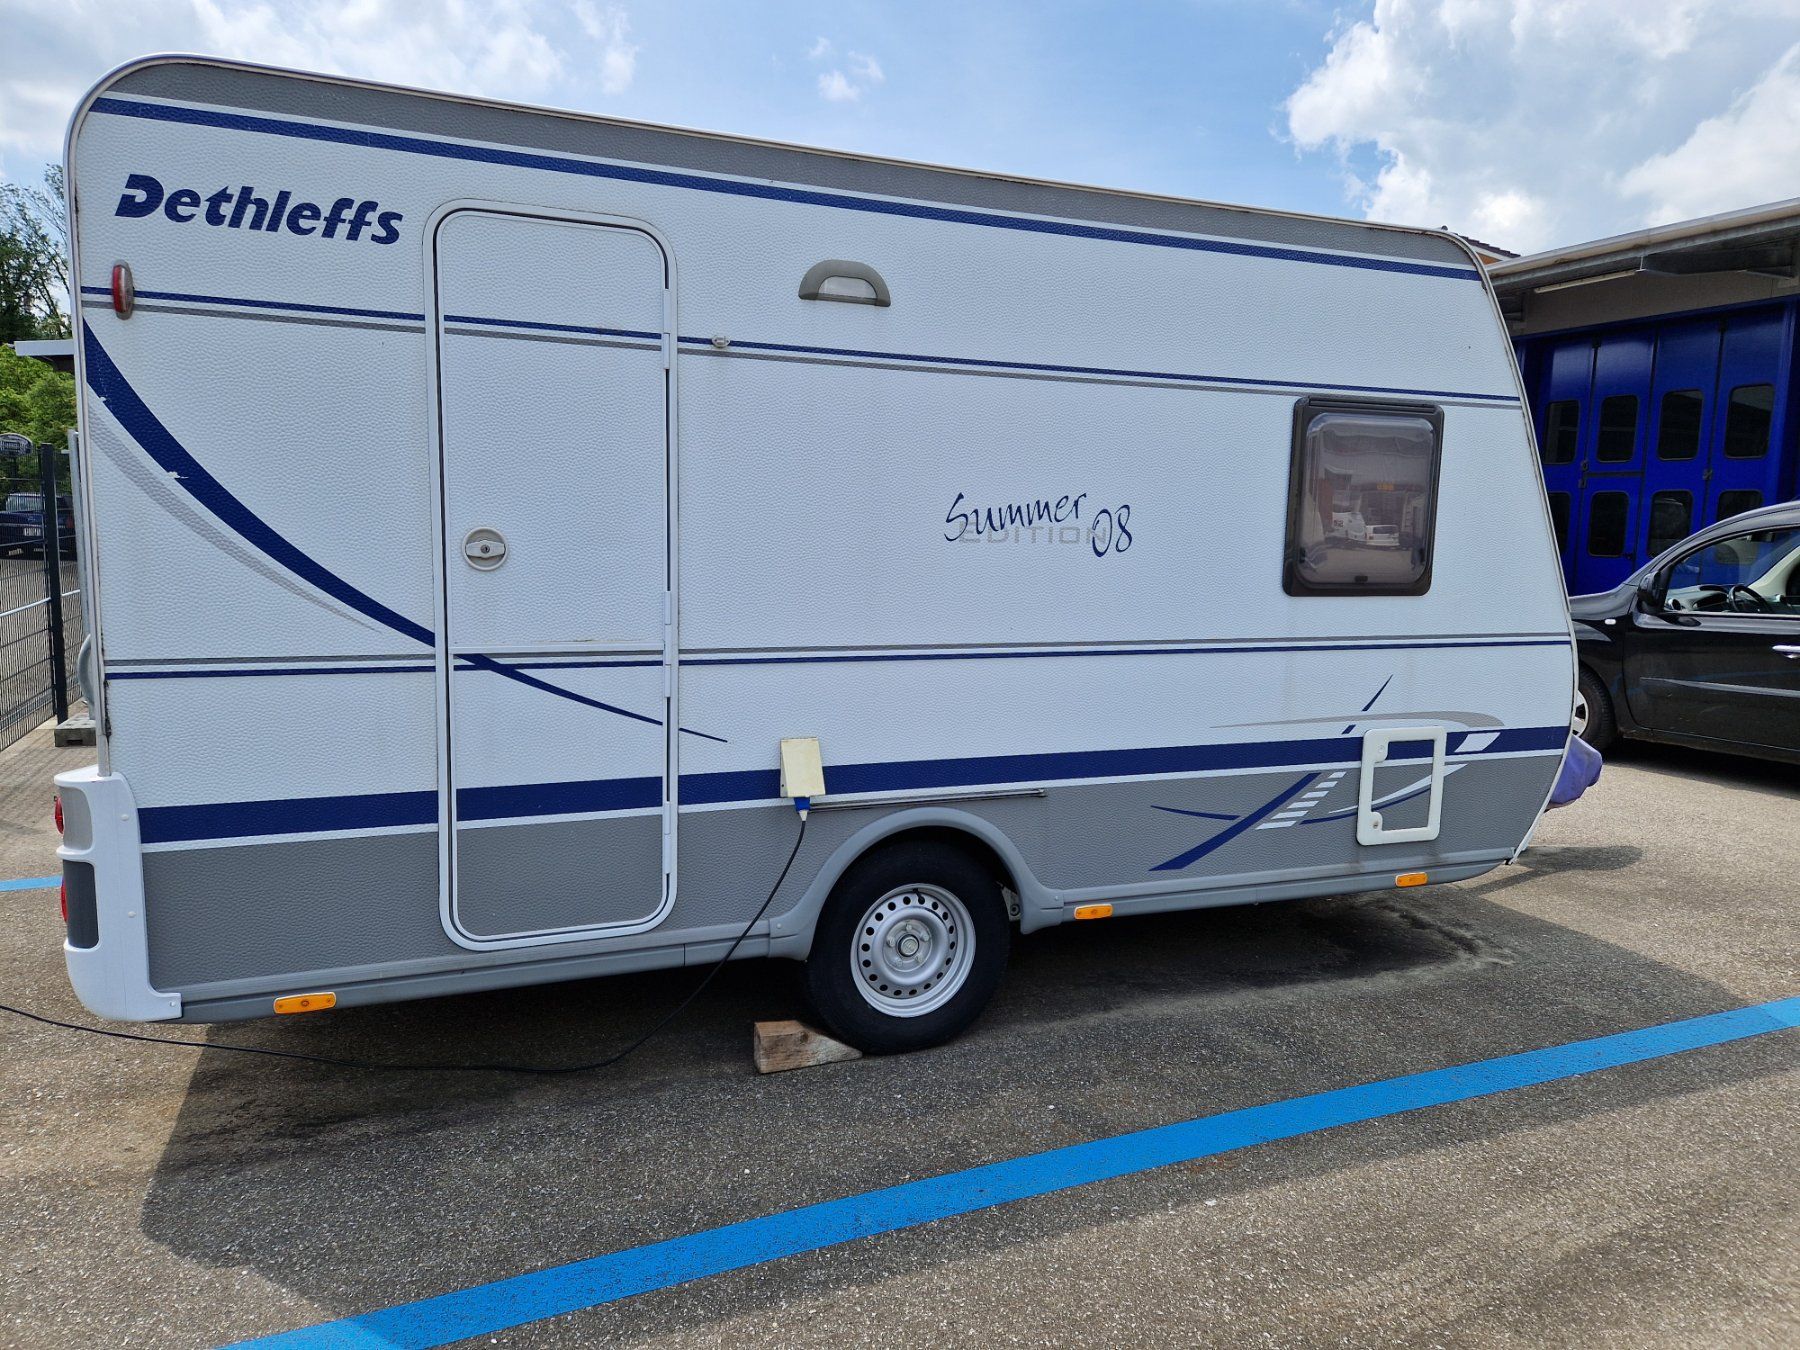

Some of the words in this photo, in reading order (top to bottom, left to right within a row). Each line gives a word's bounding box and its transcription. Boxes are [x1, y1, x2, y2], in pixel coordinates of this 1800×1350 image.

[115, 174, 403, 245] Dethleffs
[944, 492, 1087, 542] Summer
[1091, 504, 1133, 558] 08
[959, 521, 1107, 544] EDITION
